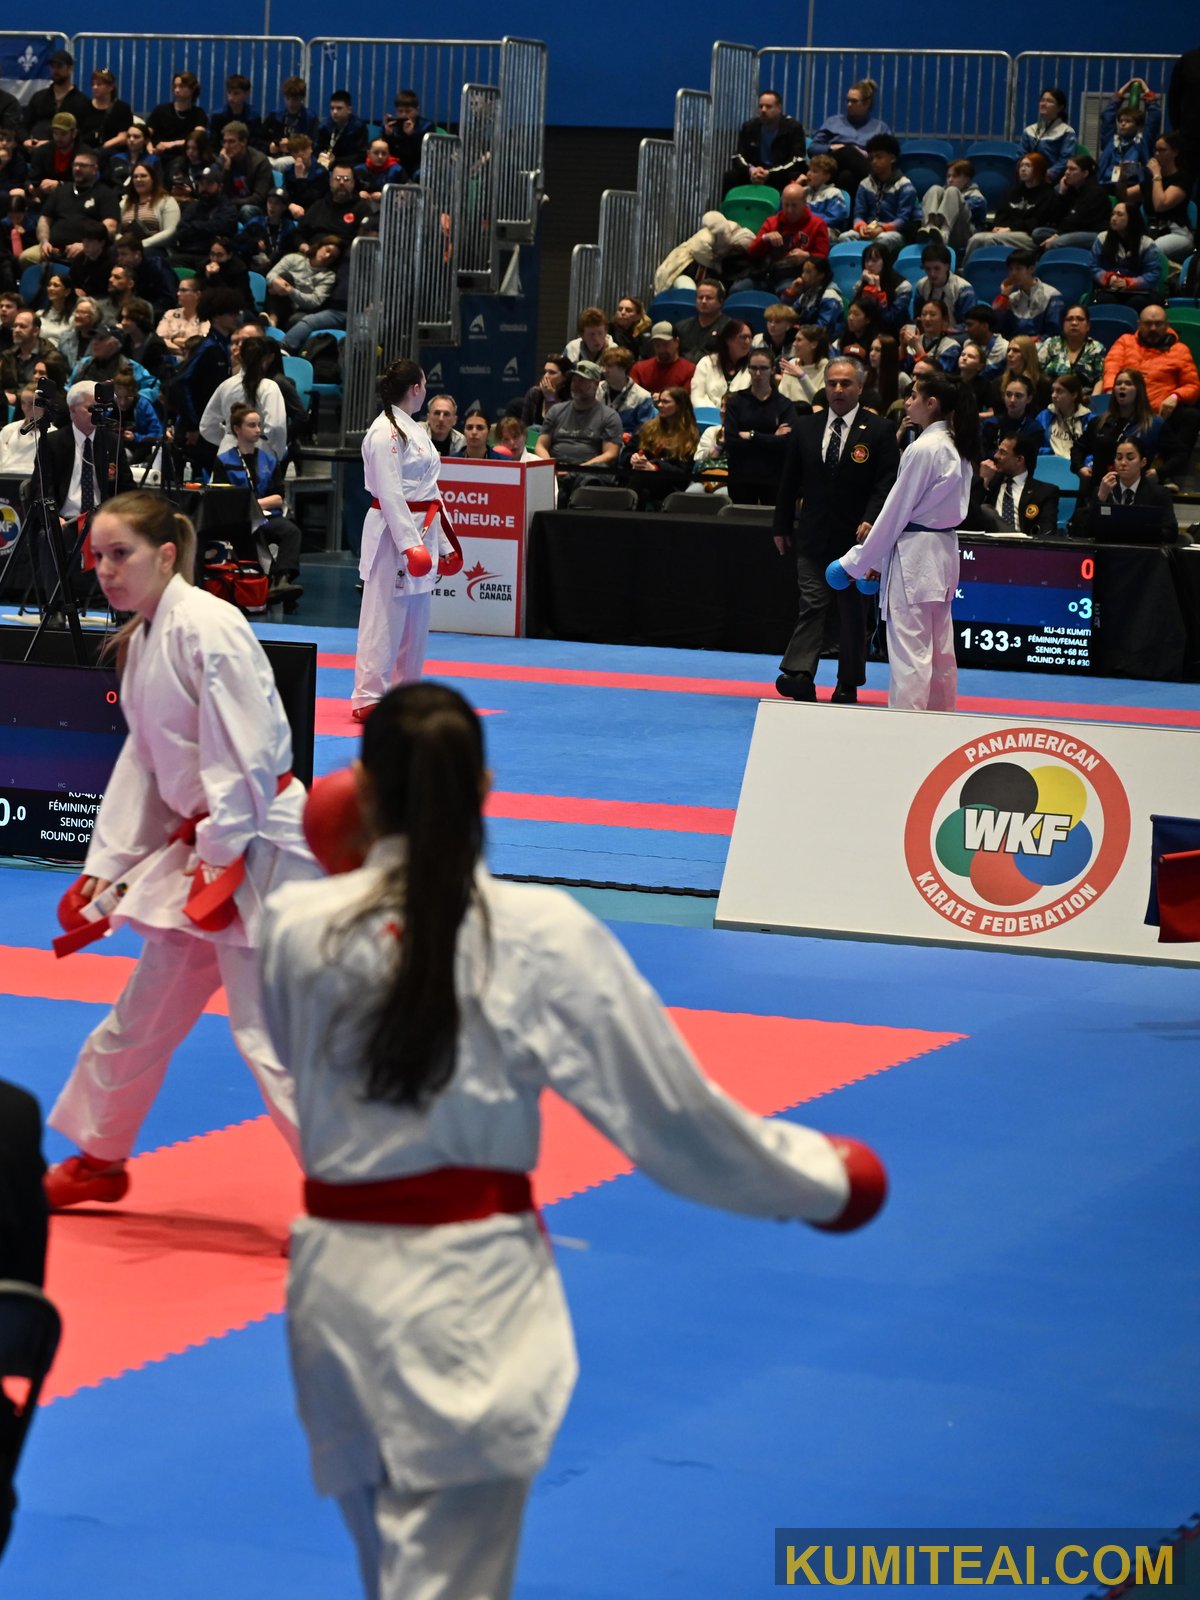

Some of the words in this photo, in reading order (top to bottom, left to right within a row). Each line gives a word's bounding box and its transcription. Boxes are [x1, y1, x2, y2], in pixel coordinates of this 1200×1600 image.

[963, 550, 976, 560] M.
[1081, 559, 1094, 579] 0
[480, 582, 512, 592] KARATE
[443, 589, 456, 597] BC
[480, 591, 512, 601] CANADA
[1044, 626, 1065, 635] KU-43
[960, 628, 1022, 652] 1:33.3
[1028, 634, 1088, 646] FÉMININ/FEMALE
[1035, 646, 1062, 654] SENIOR
[1064, 648, 1077, 656] +68
[1027, 655, 1054, 664] ROUND
[1055, 657, 1065, 665] OF
[1067, 658, 1076, 666] 16
[964, 733, 1100, 772] PANAMERICAN
[48, 799, 101, 814] FÉMININ/FE
[60, 817, 94, 828] SENIOR
[40, 830, 74, 842] ROUND
[75, 833, 91, 843] OF
[964, 808, 1072, 856] WKF
[916, 870, 976, 926] KARATE
[979, 882, 1098, 934] FEDERATION
